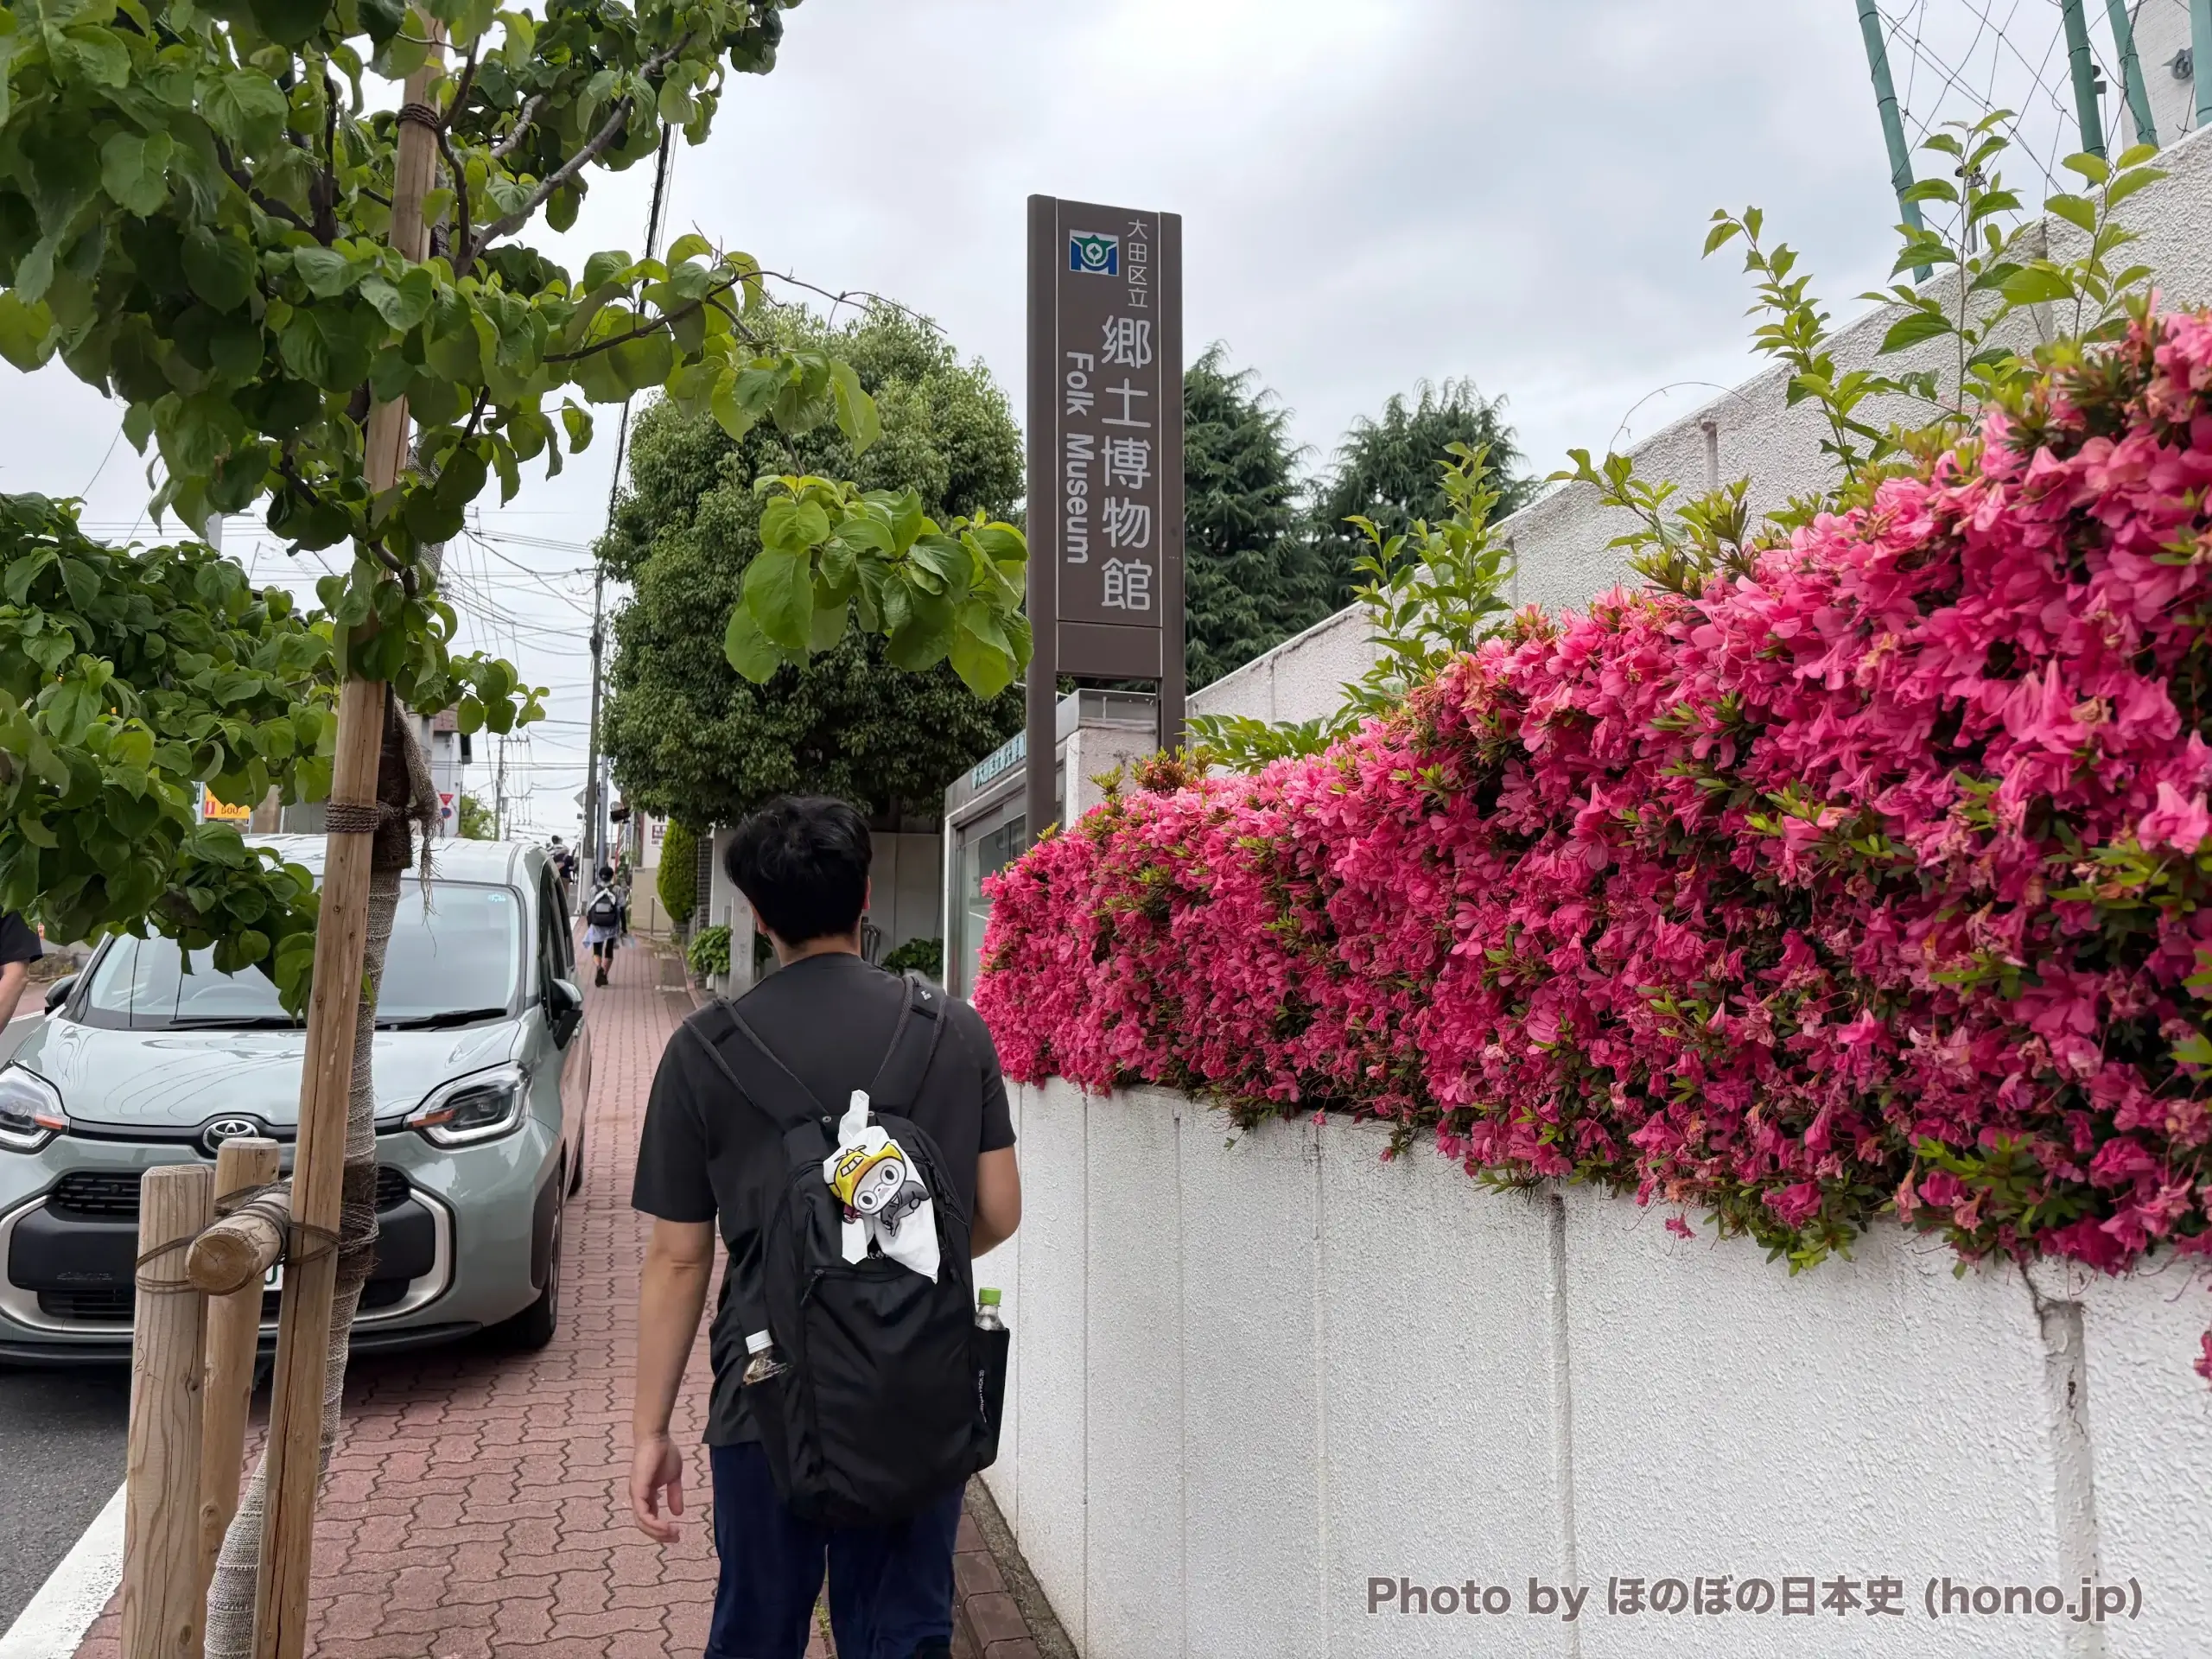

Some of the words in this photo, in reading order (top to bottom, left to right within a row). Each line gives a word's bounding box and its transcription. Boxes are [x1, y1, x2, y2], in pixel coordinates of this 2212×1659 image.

[1128, 219, 1147, 308] 大田区立
[1066, 351, 1094, 416] Folk
[1066, 433, 1095, 564] Museum
[1101, 315, 1153, 611] 郷土博物館
